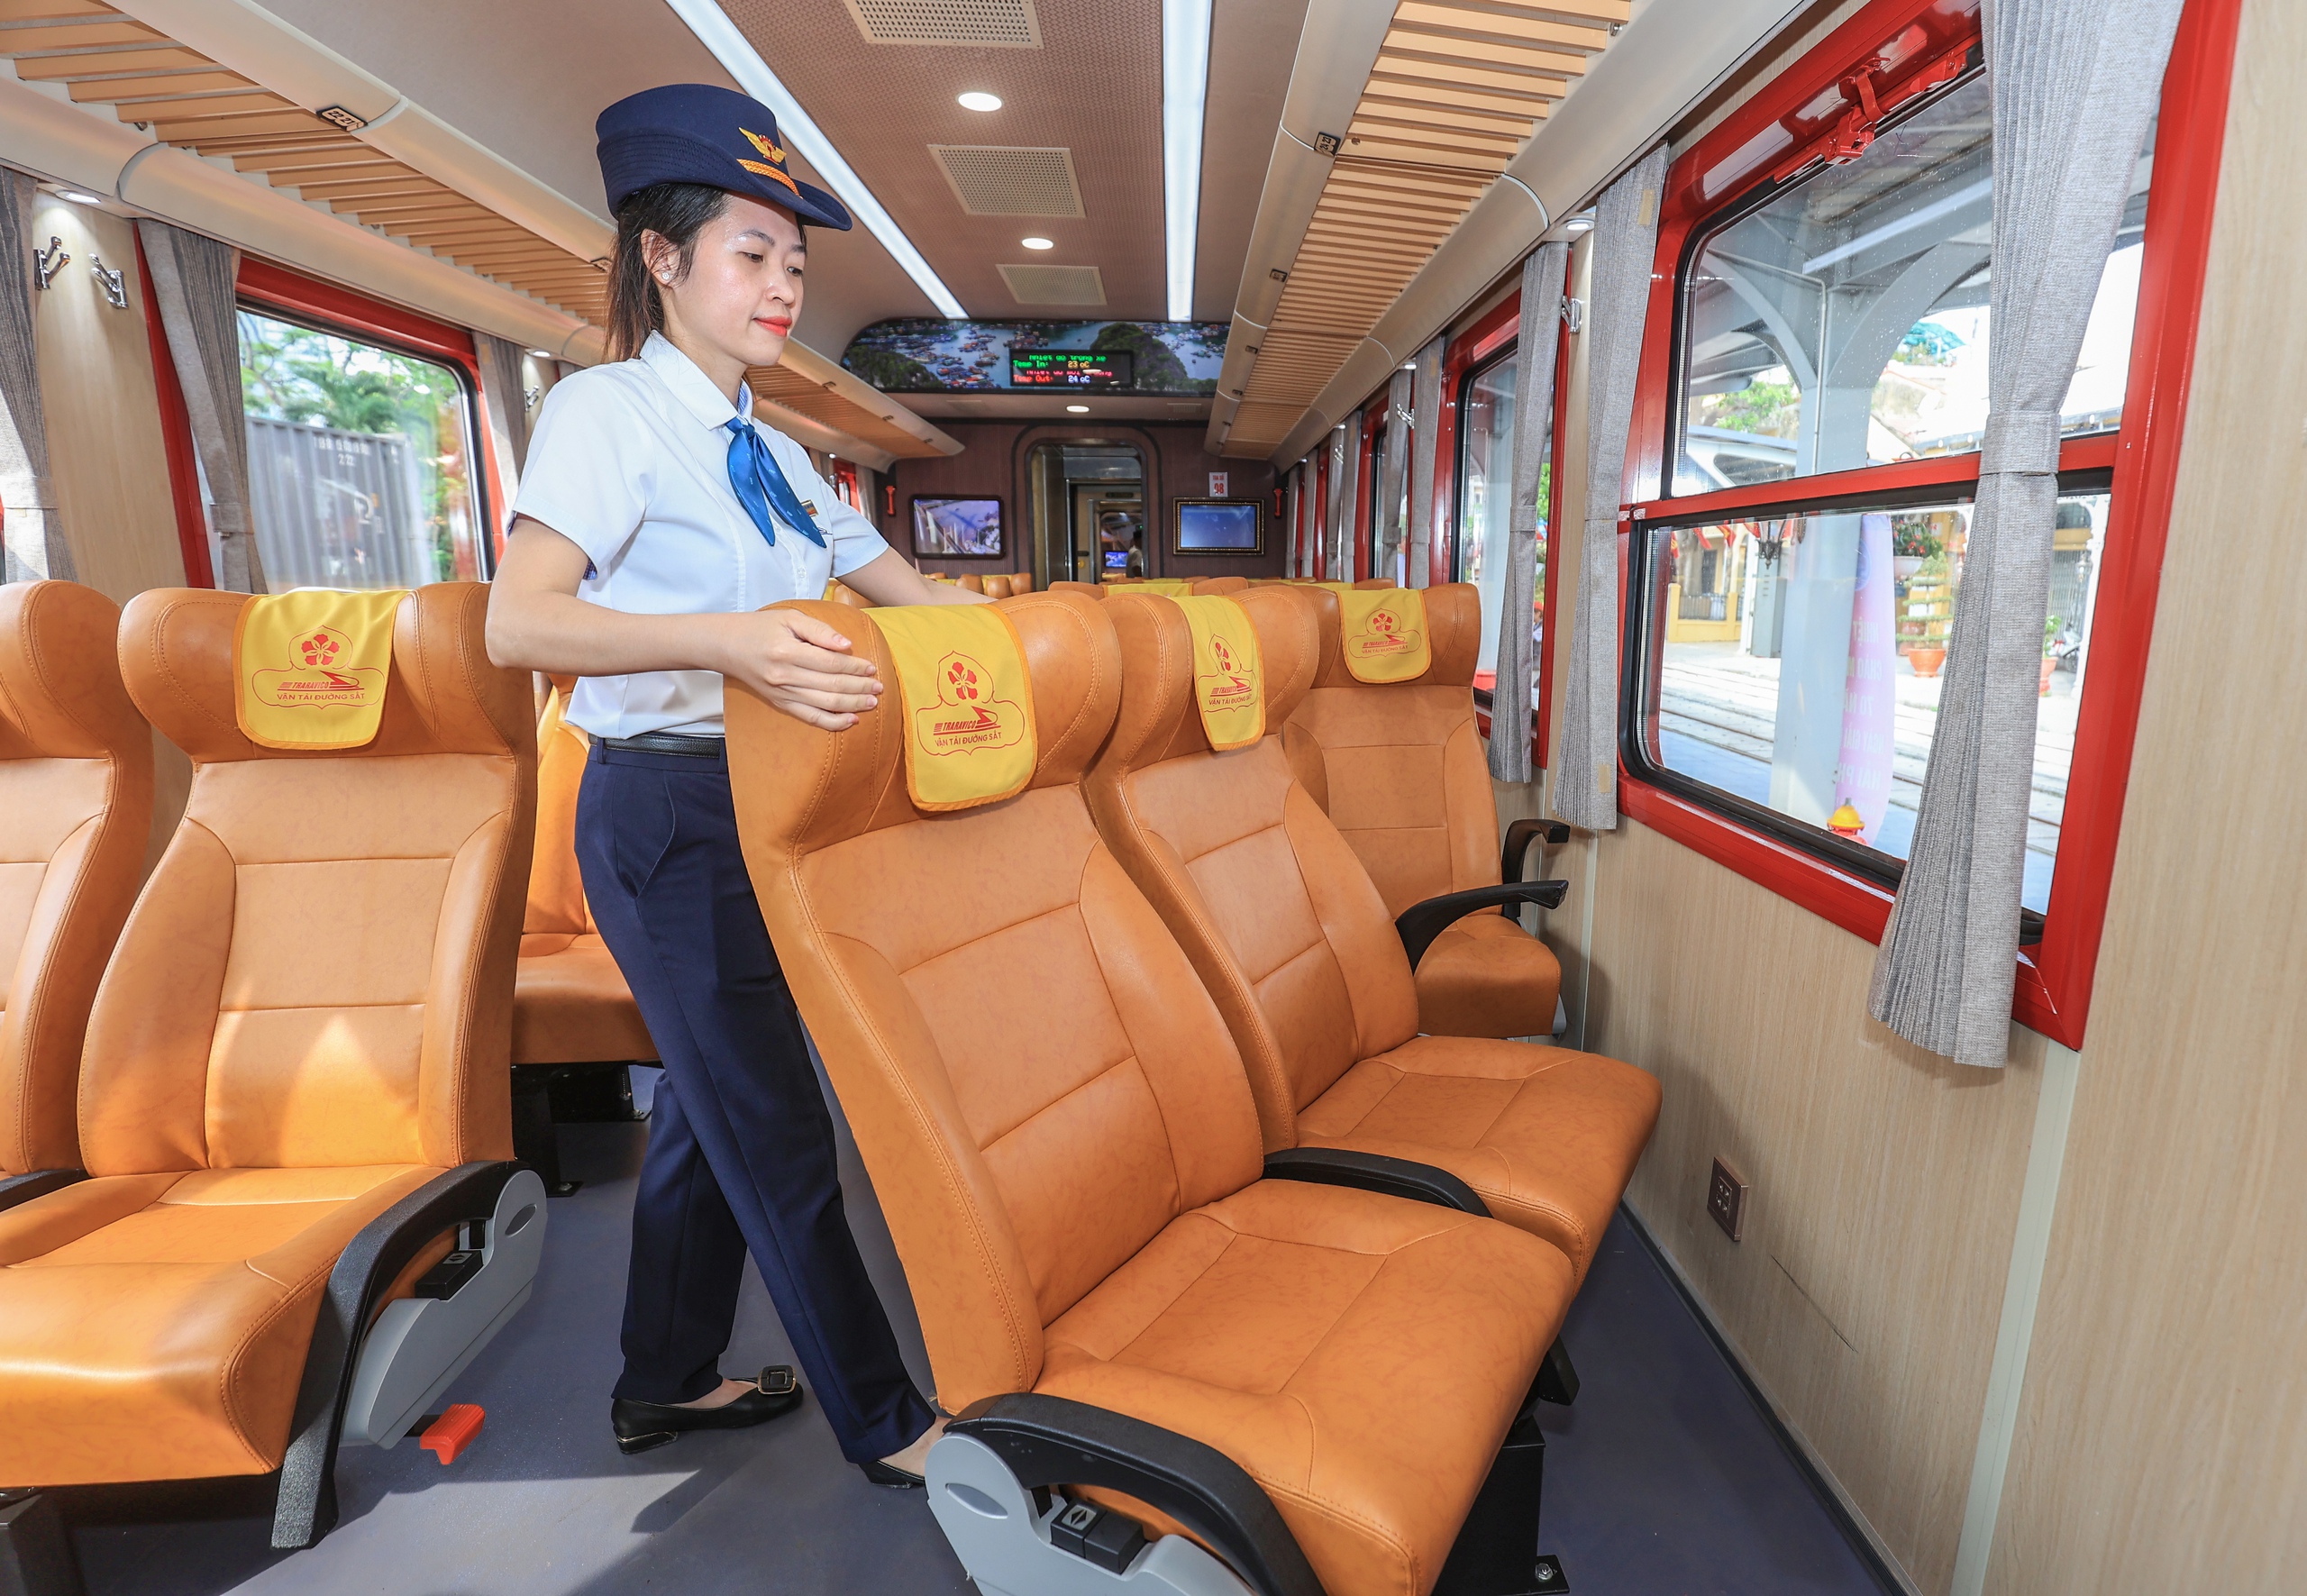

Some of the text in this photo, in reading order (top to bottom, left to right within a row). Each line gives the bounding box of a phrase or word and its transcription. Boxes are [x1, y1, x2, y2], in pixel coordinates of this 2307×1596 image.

[1068, 360, 1079, 369] 23
[1214, 482, 1225, 494] 98
[277, 693, 296, 701] VẬN
[943, 720, 976, 731] TRARAVICO
[935, 737, 948, 748] VẬN
[949, 735, 961, 745] TẢI
[962, 734, 988, 744] ĐƯỜNG
